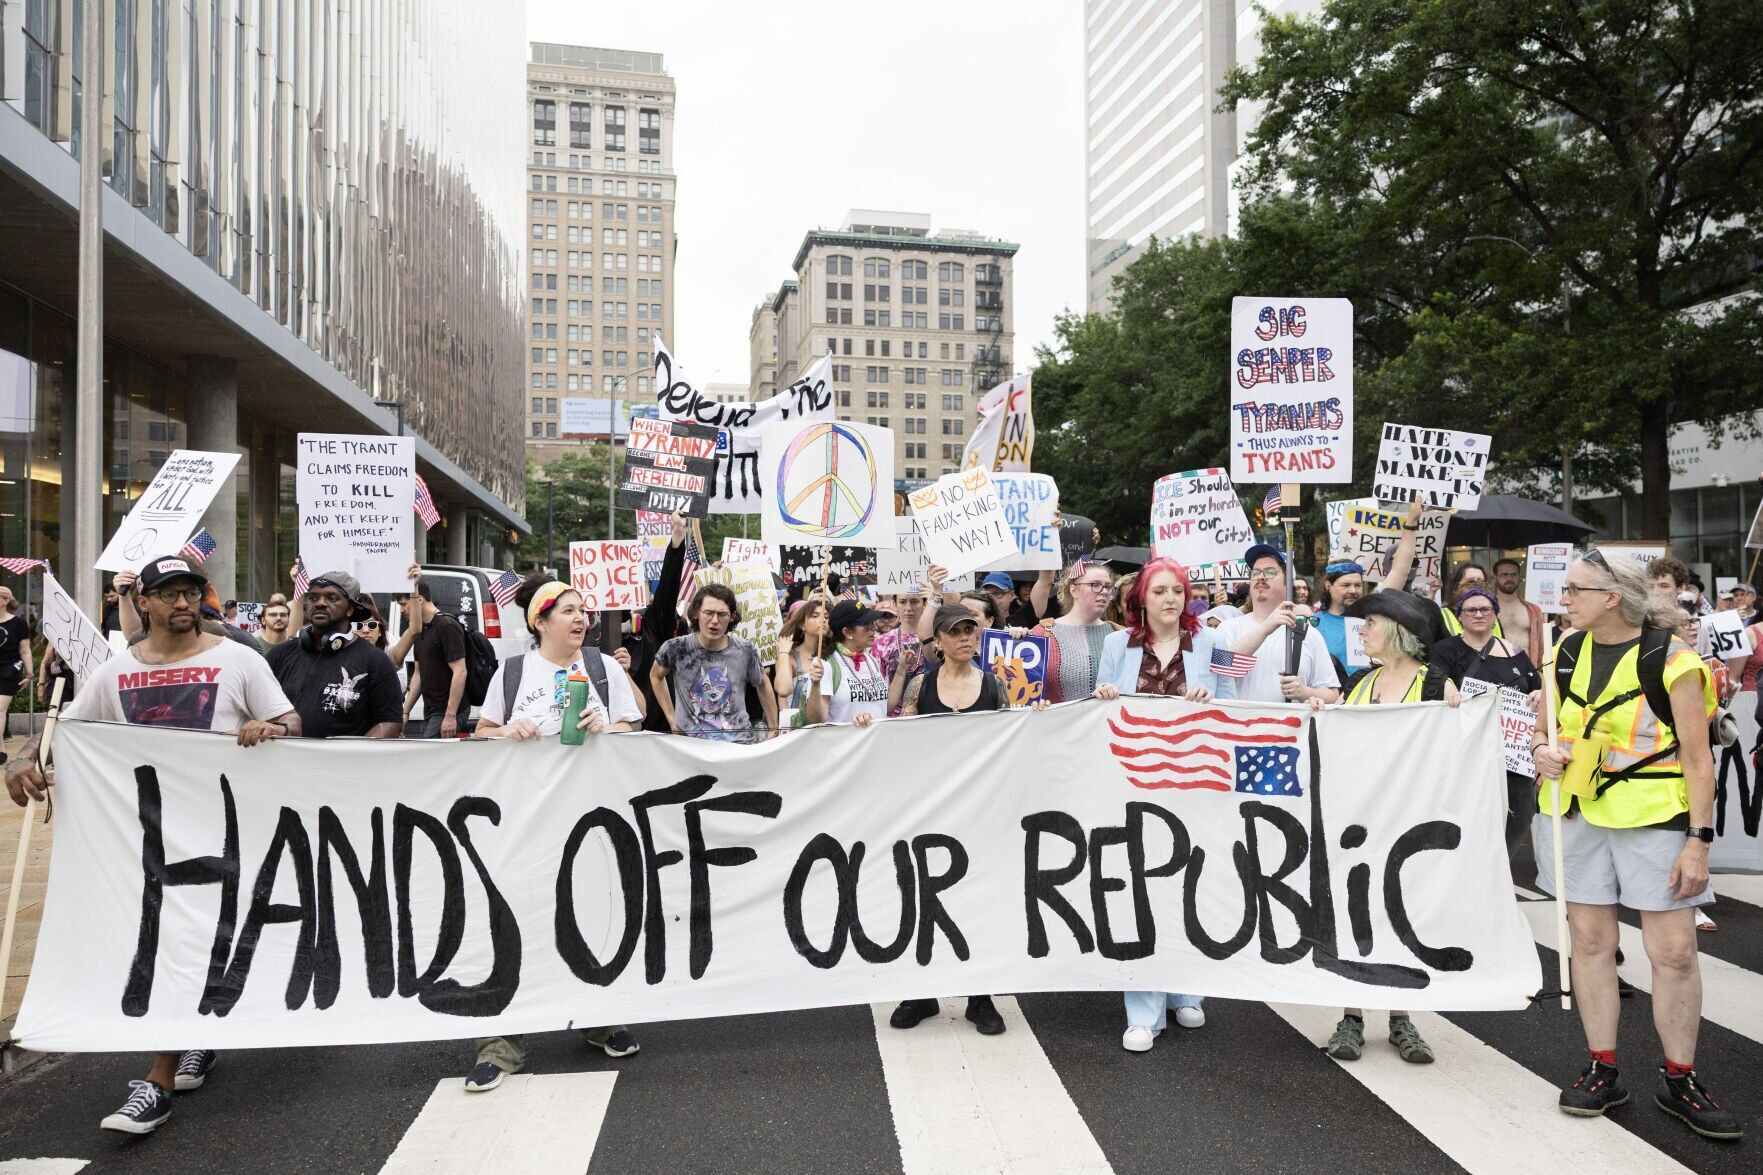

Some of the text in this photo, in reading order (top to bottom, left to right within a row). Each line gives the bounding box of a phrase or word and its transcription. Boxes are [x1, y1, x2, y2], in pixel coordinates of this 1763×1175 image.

[1255, 305, 1306, 341] SIC
[1236, 346, 1335, 389] SEMPER
[1233, 397, 1343, 433] TYRANNIS
[635, 419, 671, 434] WHEN
[1384, 425, 1452, 447] HATE
[341, 440, 398, 455] TYRANT
[630, 432, 717, 459] TYRANNY
[1248, 434, 1329, 450] THUS ALWAYS TO
[1671, 446, 1700, 456] EATIVE
[655, 453, 687, 471] LAW,
[1242, 448, 1336, 473] TYRANTS
[1411, 445, 1488, 467] WONT
[307, 463, 408, 478] CLAIMS FREEDOM
[631, 468, 705, 492] REBELLION
[1378, 459, 1482, 496] MAKE US
[321, 484, 394, 498] TO KILL
[940, 485, 964, 506] NO
[992, 479, 1051, 501] TAND
[1155, 481, 1184, 503] ICE
[1374, 483, 1458, 508] GREAT
[650, 492, 693, 511] DUTY
[1169, 502, 1185, 518] in
[1188, 503, 1207, 516] my
[304, 514, 401, 526] AND YET KEEP IT
[921, 494, 998, 537] FAUX-KING
[1002, 501, 1030, 524] OR
[1354, 510, 1444, 531] IKEA HAS
[317, 530, 336, 541] FOR
[1010, 525, 1054, 555] TICE
[1159, 519, 1196, 540] NOT
[728, 539, 769, 560] Fight
[899, 535, 927, 553] KIN
[1359, 533, 1438, 555] BETER
[572, 546, 597, 568] NO
[600, 542, 642, 563] KINGS
[809, 545, 833, 565] IS
[793, 560, 851, 583] AMONG
[1354, 554, 1441, 578] CAETS
[573, 565, 639, 590] NO ICE
[887, 570, 968, 585] AMEA
[238, 603, 258, 613] STOP
[584, 594, 598, 610] O
[988, 637, 1042, 670] NO
[118, 667, 222, 689] MISERY
[1464, 680, 1488, 691] SOCIA
[1499, 689, 1529, 700] CURIT
[1502, 729, 1524, 744] FF
[121, 765, 522, 1018] HANDS
[555, 775, 782, 987] OFF
[784, 832, 969, 969] OUR
